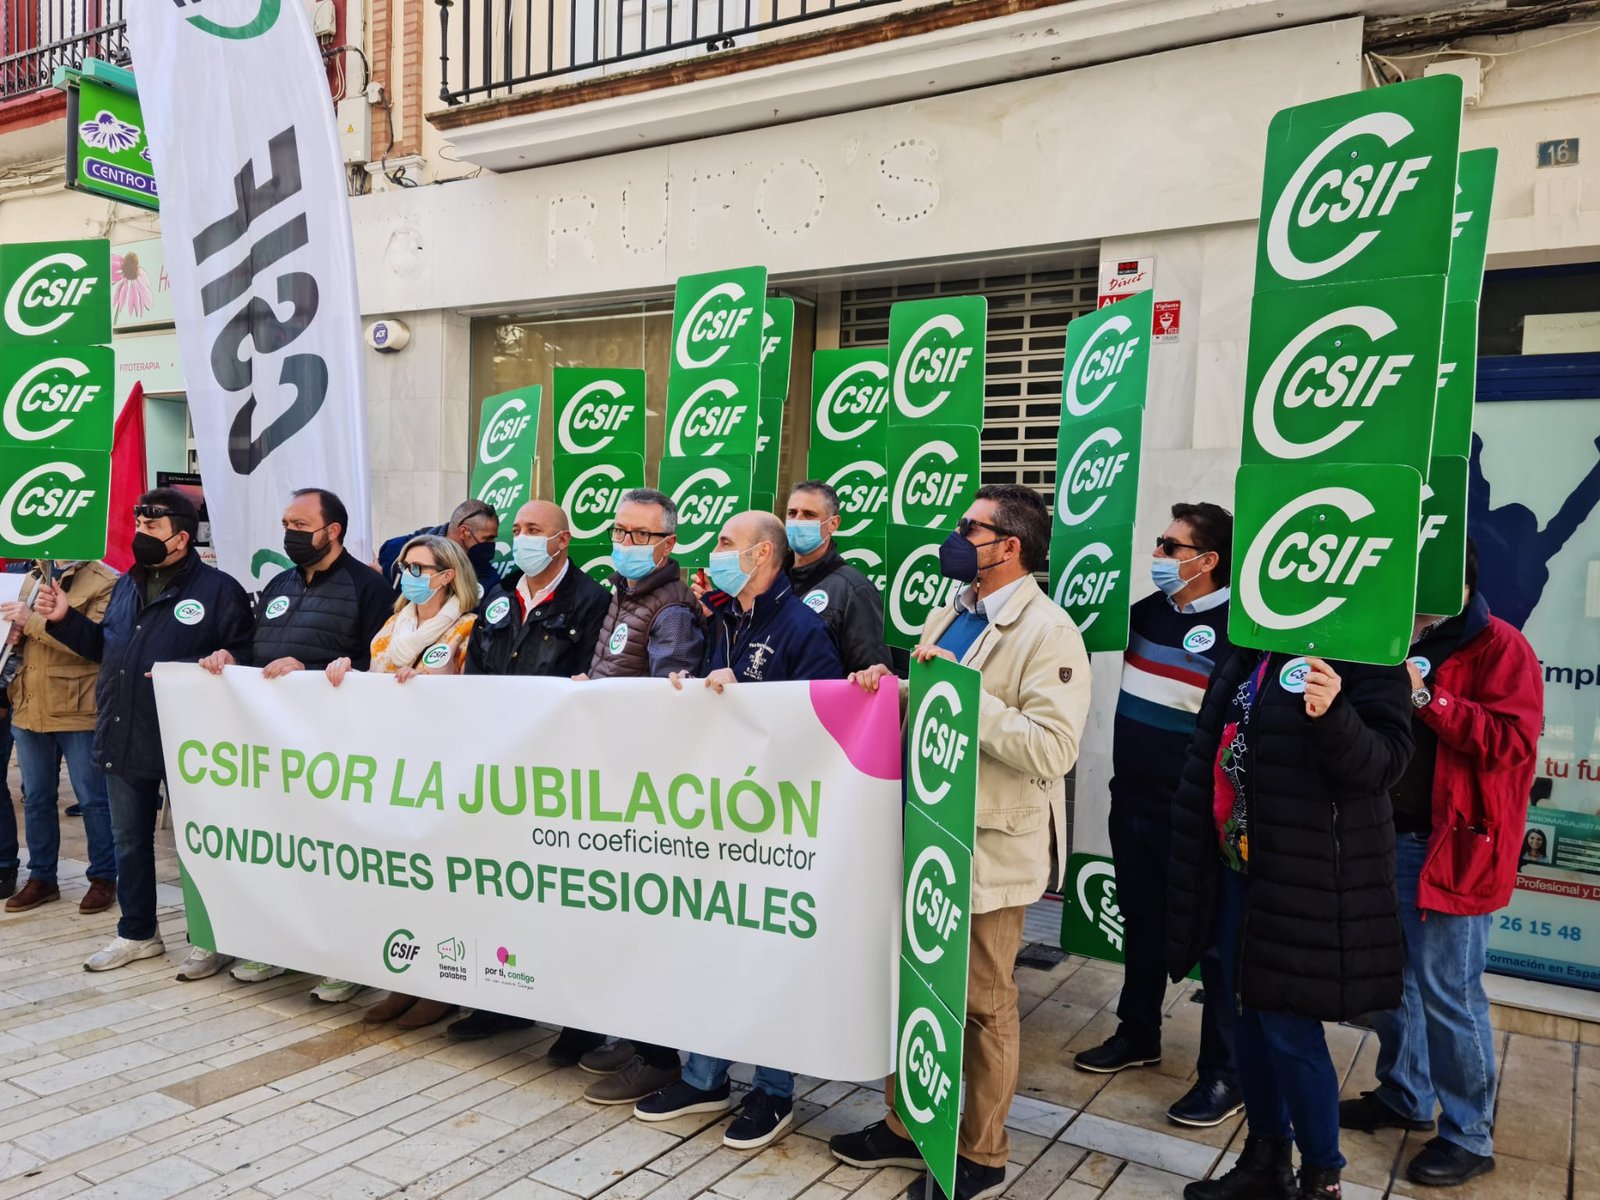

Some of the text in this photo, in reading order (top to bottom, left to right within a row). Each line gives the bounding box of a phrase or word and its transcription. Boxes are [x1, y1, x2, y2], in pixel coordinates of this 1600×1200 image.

[1547, 143, 1569, 165] 16
[92, 164, 146, 188] CENTRO
[1297, 155, 1432, 228] CSIF
[23, 277, 98, 308] CSIF
[193, 124, 329, 475] CSIF
[691, 307, 754, 343] CSIF
[119, 362, 160, 373] FITOTERAPIA
[908, 347, 973, 384] CSIF
[1080, 336, 1140, 386] CSIF
[21, 382, 101, 413] CSIF
[1283, 354, 1415, 409] CSIF
[489, 414, 532, 444] CSIF
[573, 403, 635, 431] CSIF
[684, 405, 748, 438] CSIF
[905, 470, 969, 507] CSIF
[1071, 452, 1130, 495] CSIF
[16, 486, 96, 518] CSIF
[677, 494, 739, 525] CSIF
[1268, 531, 1393, 585] CSIF
[1064, 570, 1121, 607] CSIF
[1539, 661, 1600, 690] mpl
[921, 716, 970, 775] CSIF
[1545, 757, 1568, 778] tu
[177, 739, 823, 839] CSIF POR LA JUBILACIÓN
[532, 827, 817, 871] con coeficiente reductor
[184, 820, 818, 939] CONDUCTORES PROFESIONALES
[1516, 876, 1580, 895] Profesional
[1582, 888, 1591, 898] y
[916, 877, 962, 942] CSIF
[1500, 915, 1522, 932] 26
[1529, 920, 1551, 936] 15
[1557, 925, 1582, 942] 48
[390, 942, 421, 961] CSIF
[438, 963, 467, 974] tienes la
[439, 971, 467, 981] palabra
[484, 967, 498, 976] por
[507, 971, 535, 984] contigo
[1548, 964, 1563, 974] en
[908, 1036, 952, 1107] CSIF
